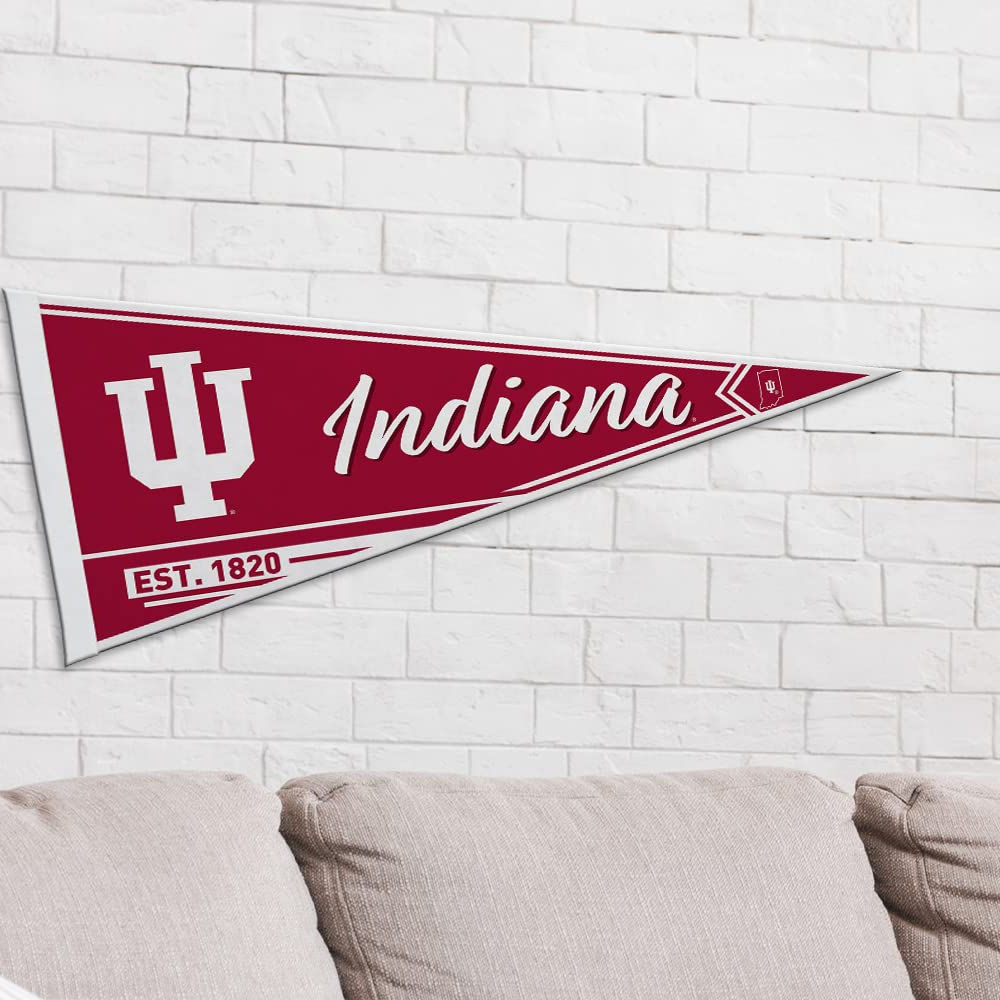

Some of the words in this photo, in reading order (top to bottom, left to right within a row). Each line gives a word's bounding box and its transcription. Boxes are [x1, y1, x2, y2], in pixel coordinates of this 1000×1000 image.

[104, 351, 255, 522] IU
[323, 364, 692, 475] Indiana
[133, 563, 203, 594] EST.
[211, 551, 281, 582] 1820
